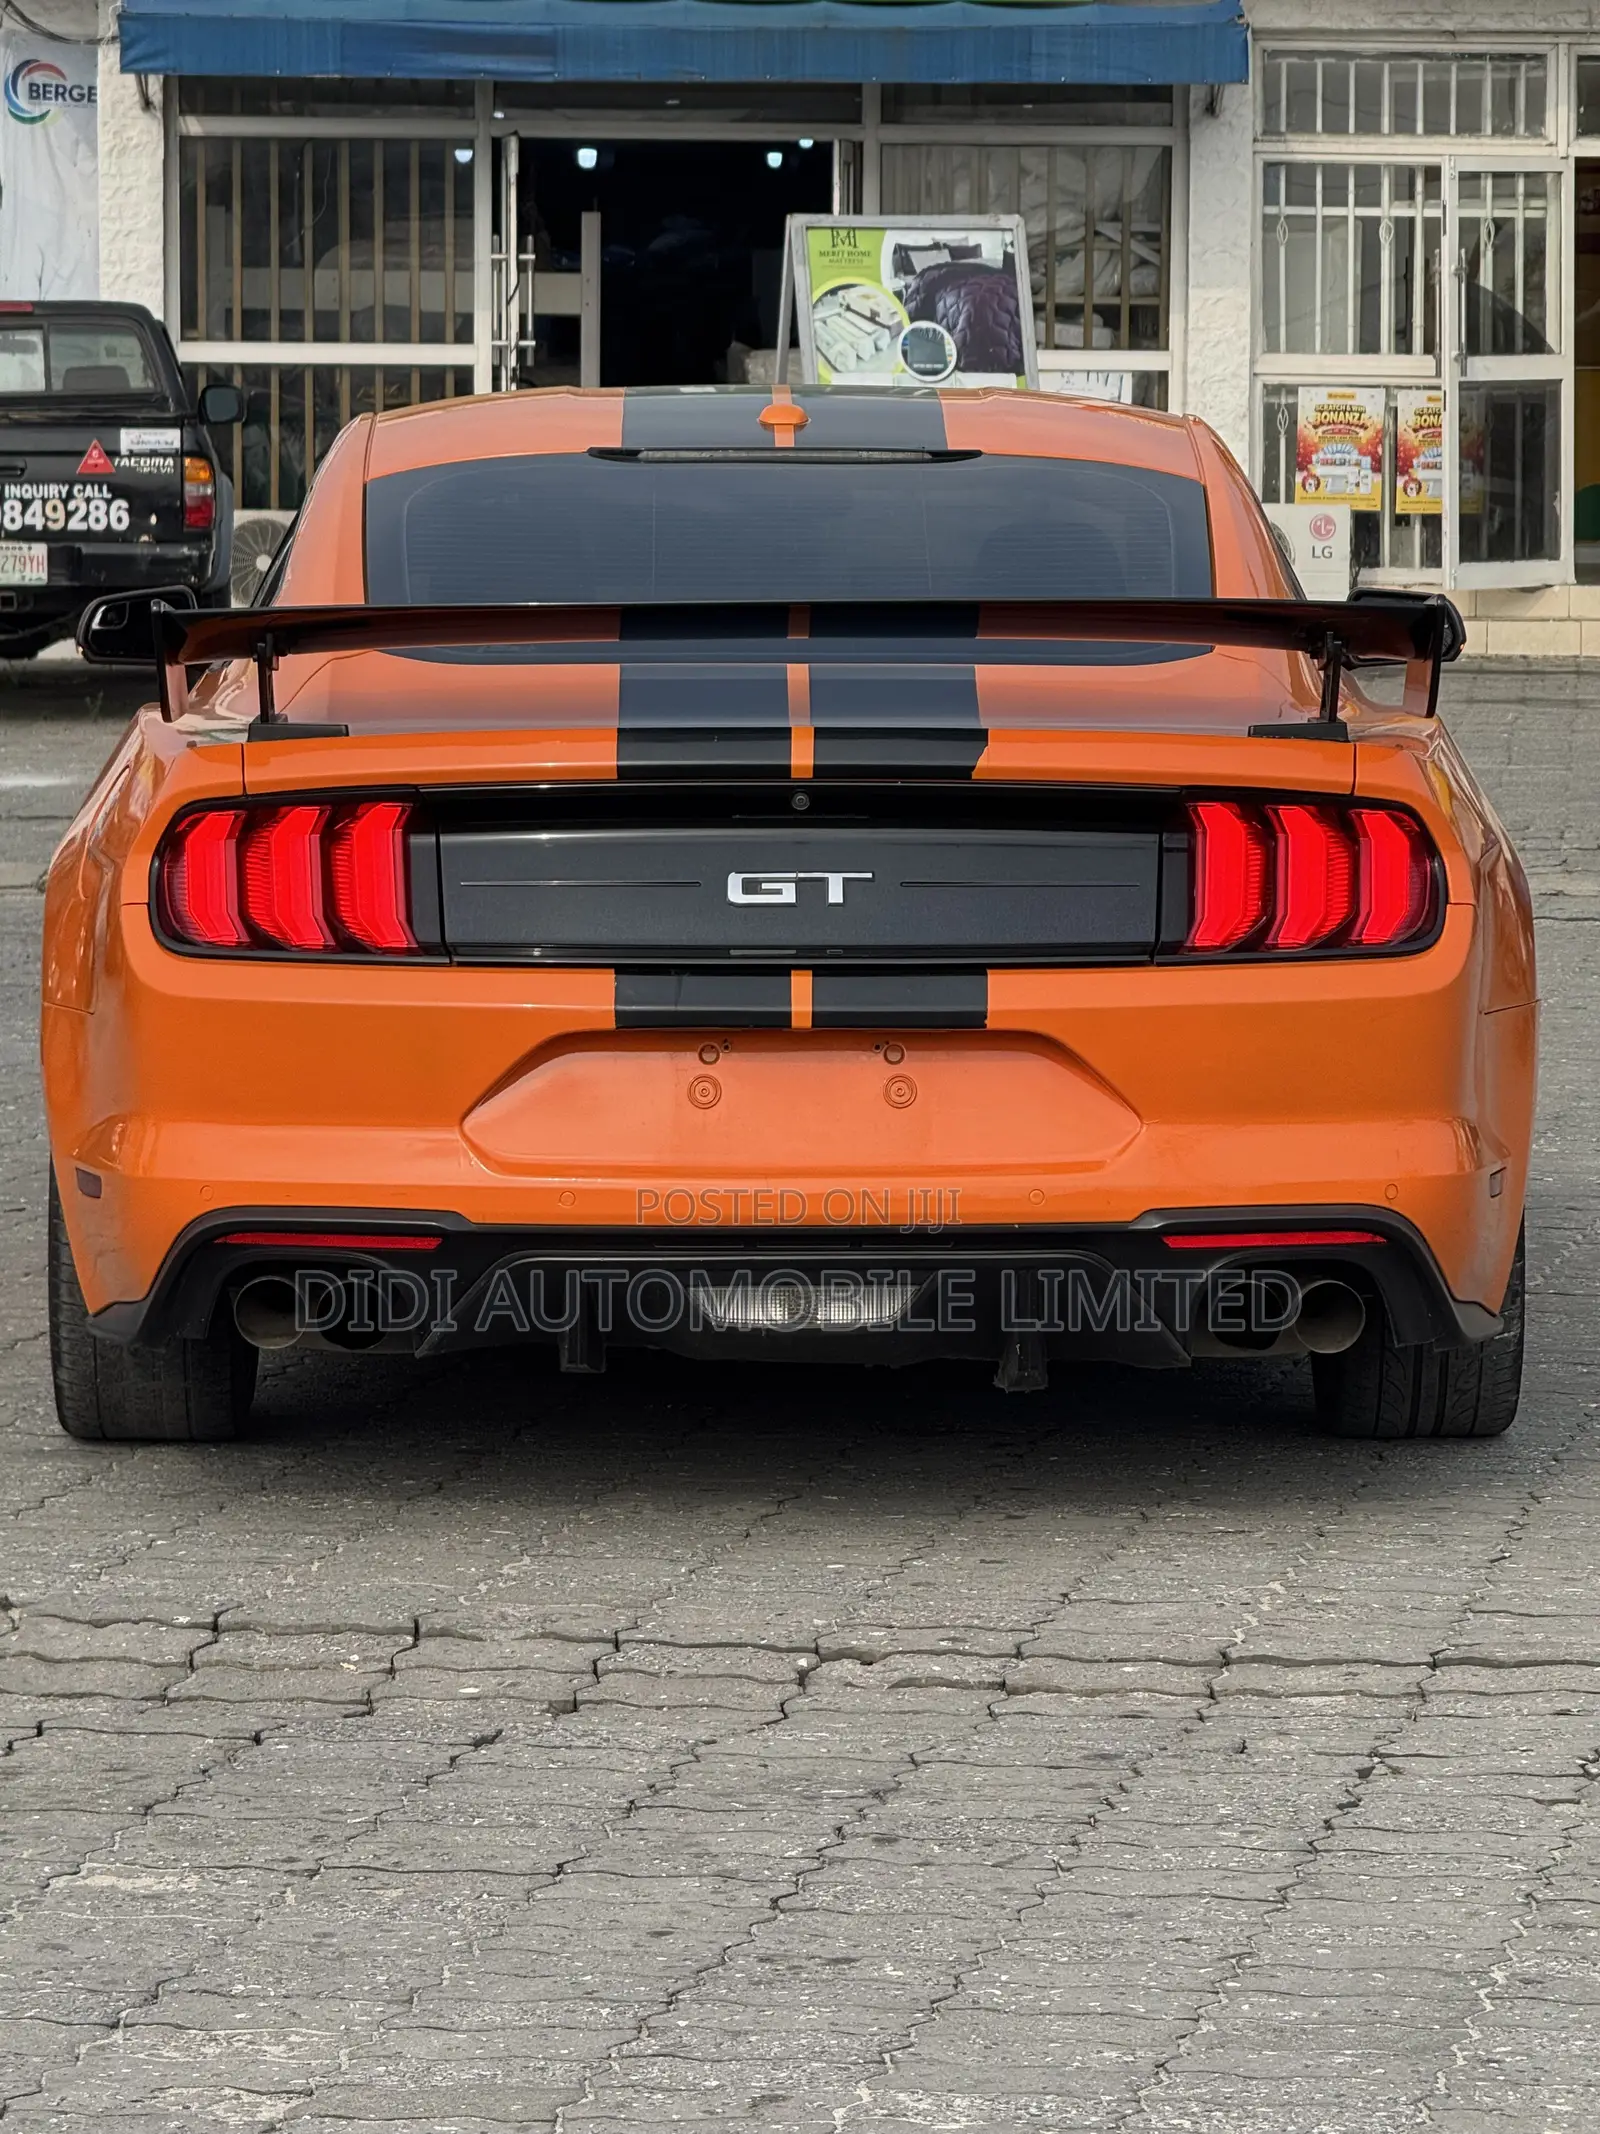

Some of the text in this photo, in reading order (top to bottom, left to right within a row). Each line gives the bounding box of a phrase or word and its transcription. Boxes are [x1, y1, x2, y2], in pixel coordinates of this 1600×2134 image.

[28, 82, 97, 103] BERGE
[1315, 404, 1346, 412] SCRATCH
[1314, 411, 1367, 427] BONANZA
[4, 483, 112, 499] INQUIRY CALL
[0, 499, 130, 531] 849286
[1311, 545, 1333, 559] LG
[727, 871, 874, 906] GT
